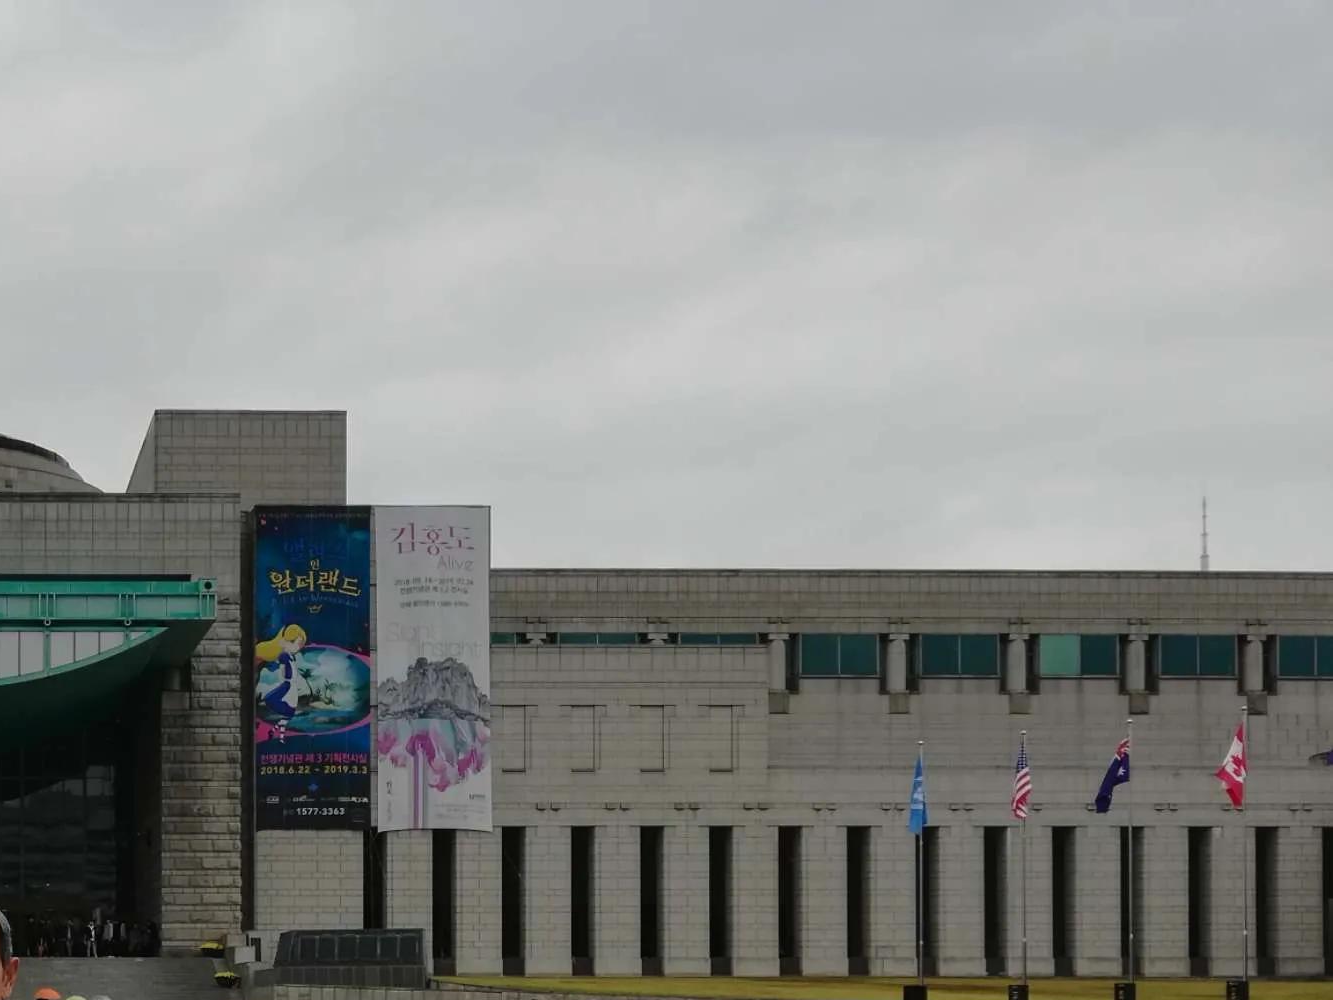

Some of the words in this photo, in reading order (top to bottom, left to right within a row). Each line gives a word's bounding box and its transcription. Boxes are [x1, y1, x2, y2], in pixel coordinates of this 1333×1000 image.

[390, 521, 475, 556] 김홍도
[309, 558, 320, 571] 인
[437, 555, 474, 572] Alive
[269, 568, 362, 597] 원더랜드
[260, 765, 311, 776] 2018.6.22
[324, 765, 369, 775] 2019.3.3
